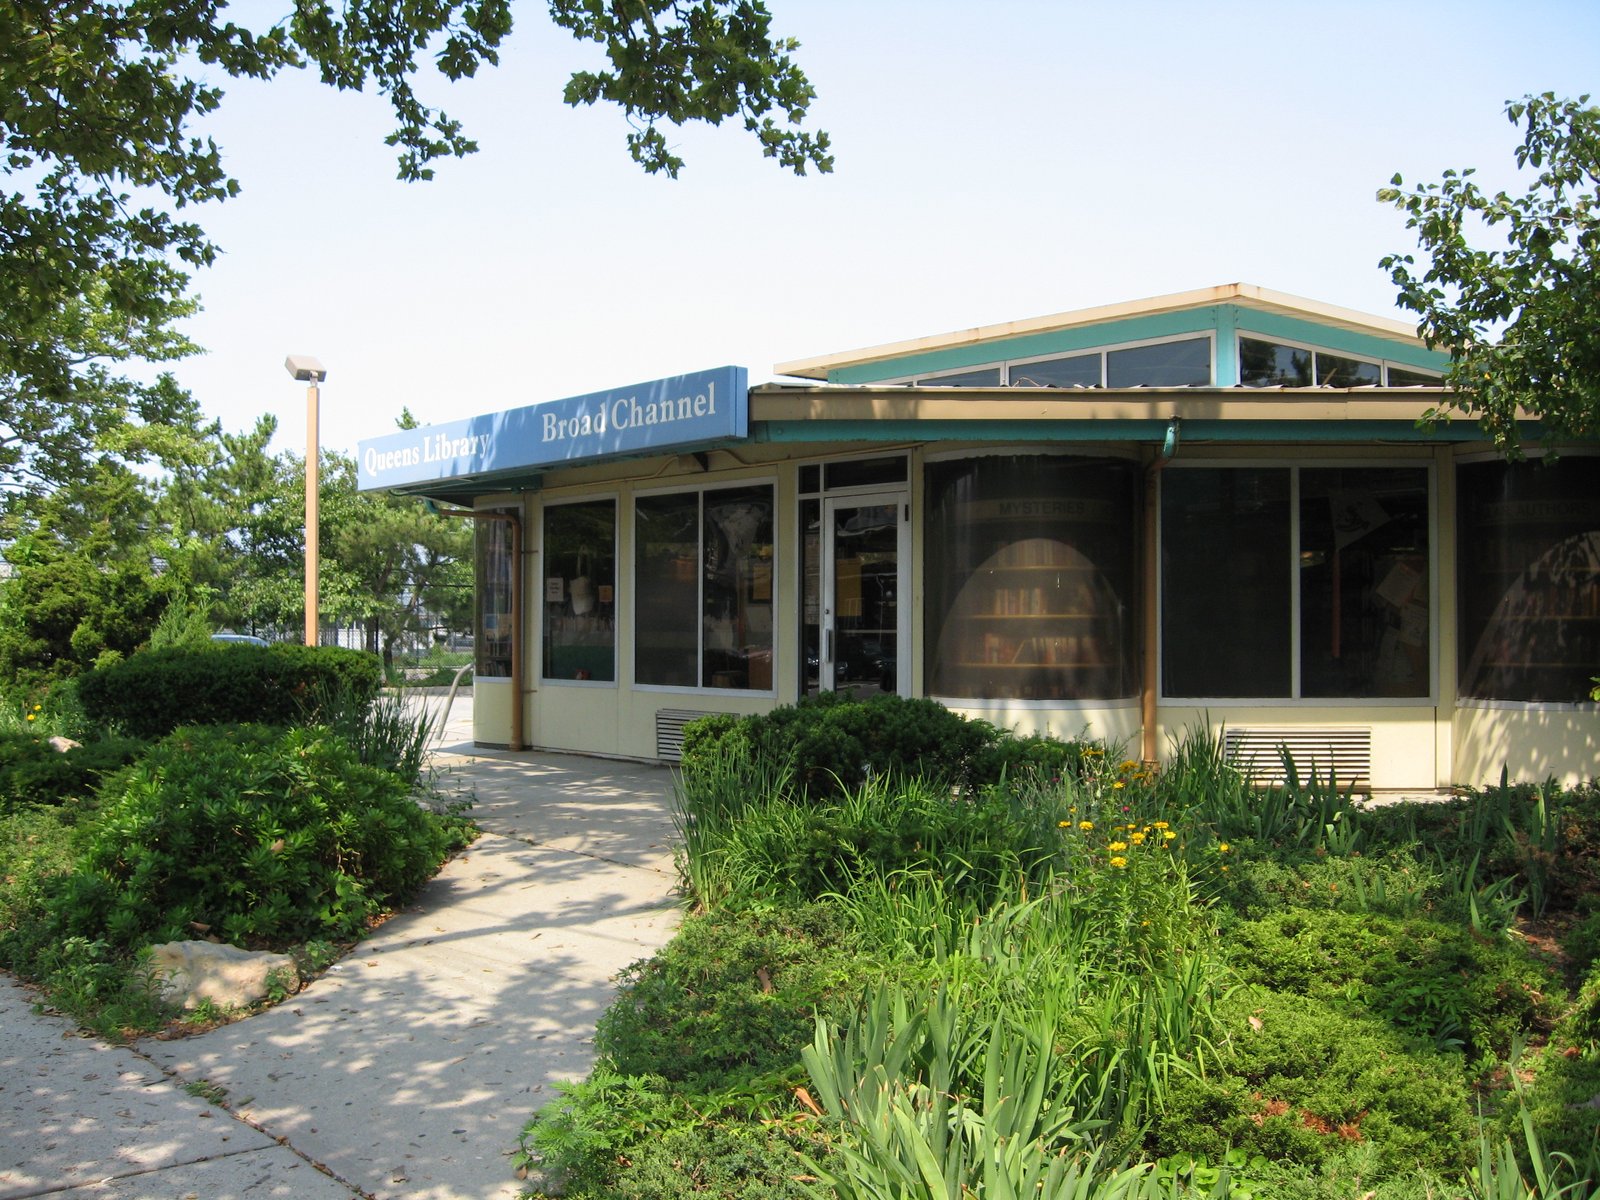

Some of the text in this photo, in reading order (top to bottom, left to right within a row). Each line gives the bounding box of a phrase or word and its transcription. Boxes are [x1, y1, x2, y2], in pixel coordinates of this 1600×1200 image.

[364, 381, 716, 477] Queens Library Broad Channel
[1000, 501, 1085, 515] MYSTERIES
